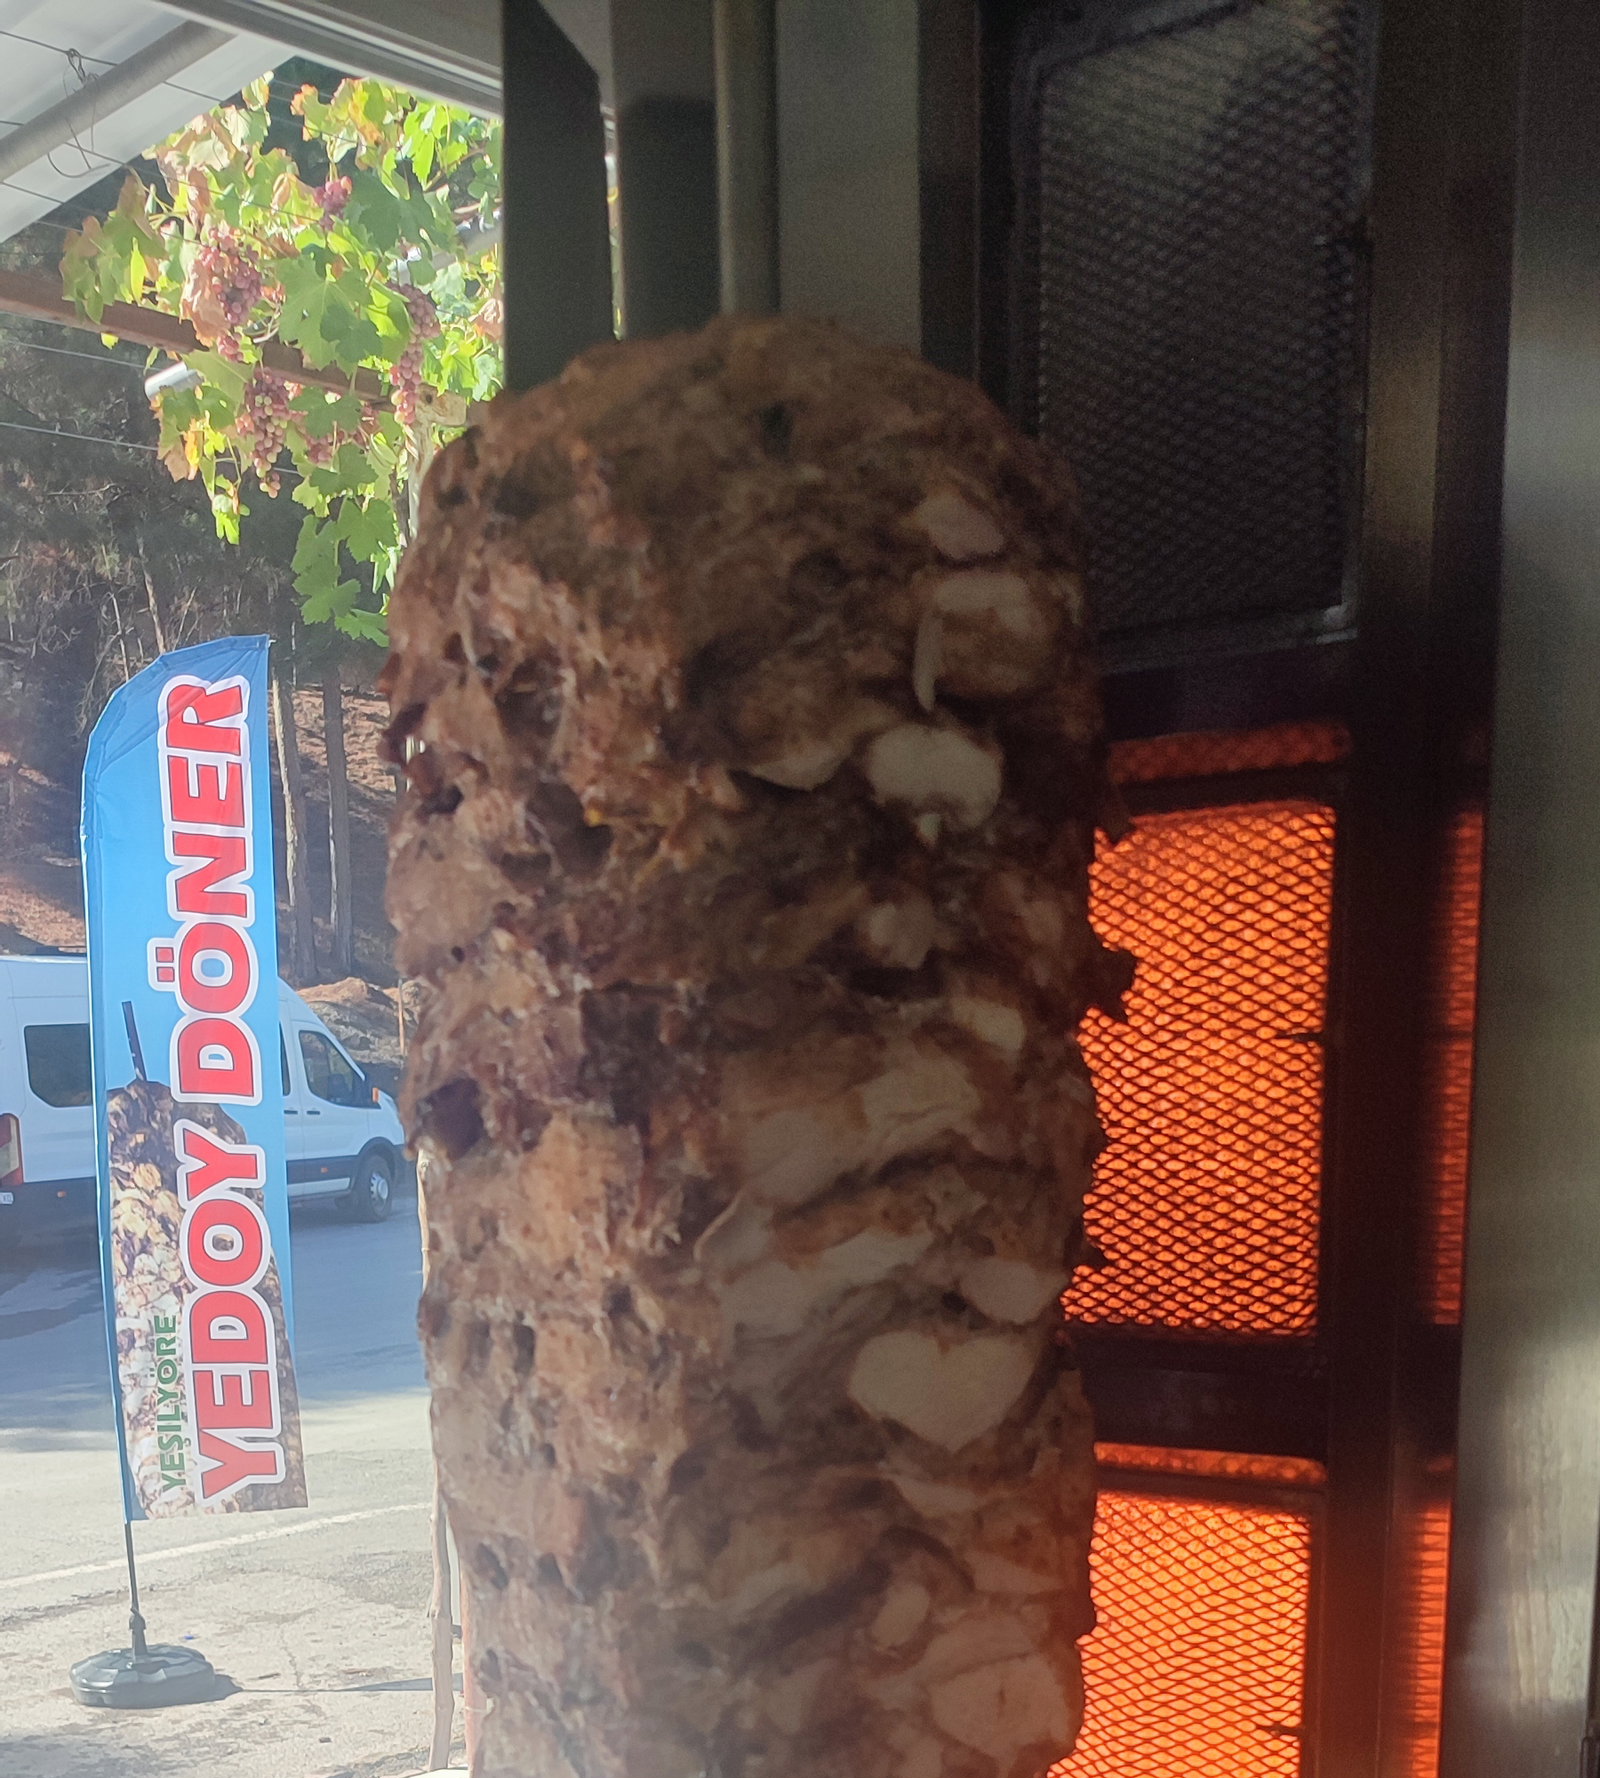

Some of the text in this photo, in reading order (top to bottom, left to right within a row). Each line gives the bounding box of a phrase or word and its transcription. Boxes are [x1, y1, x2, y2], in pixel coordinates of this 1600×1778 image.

[154, 680, 280, 1501] YEDOY DÖNER
[150, 1314, 192, 1492] YEŞİLYÖRE
